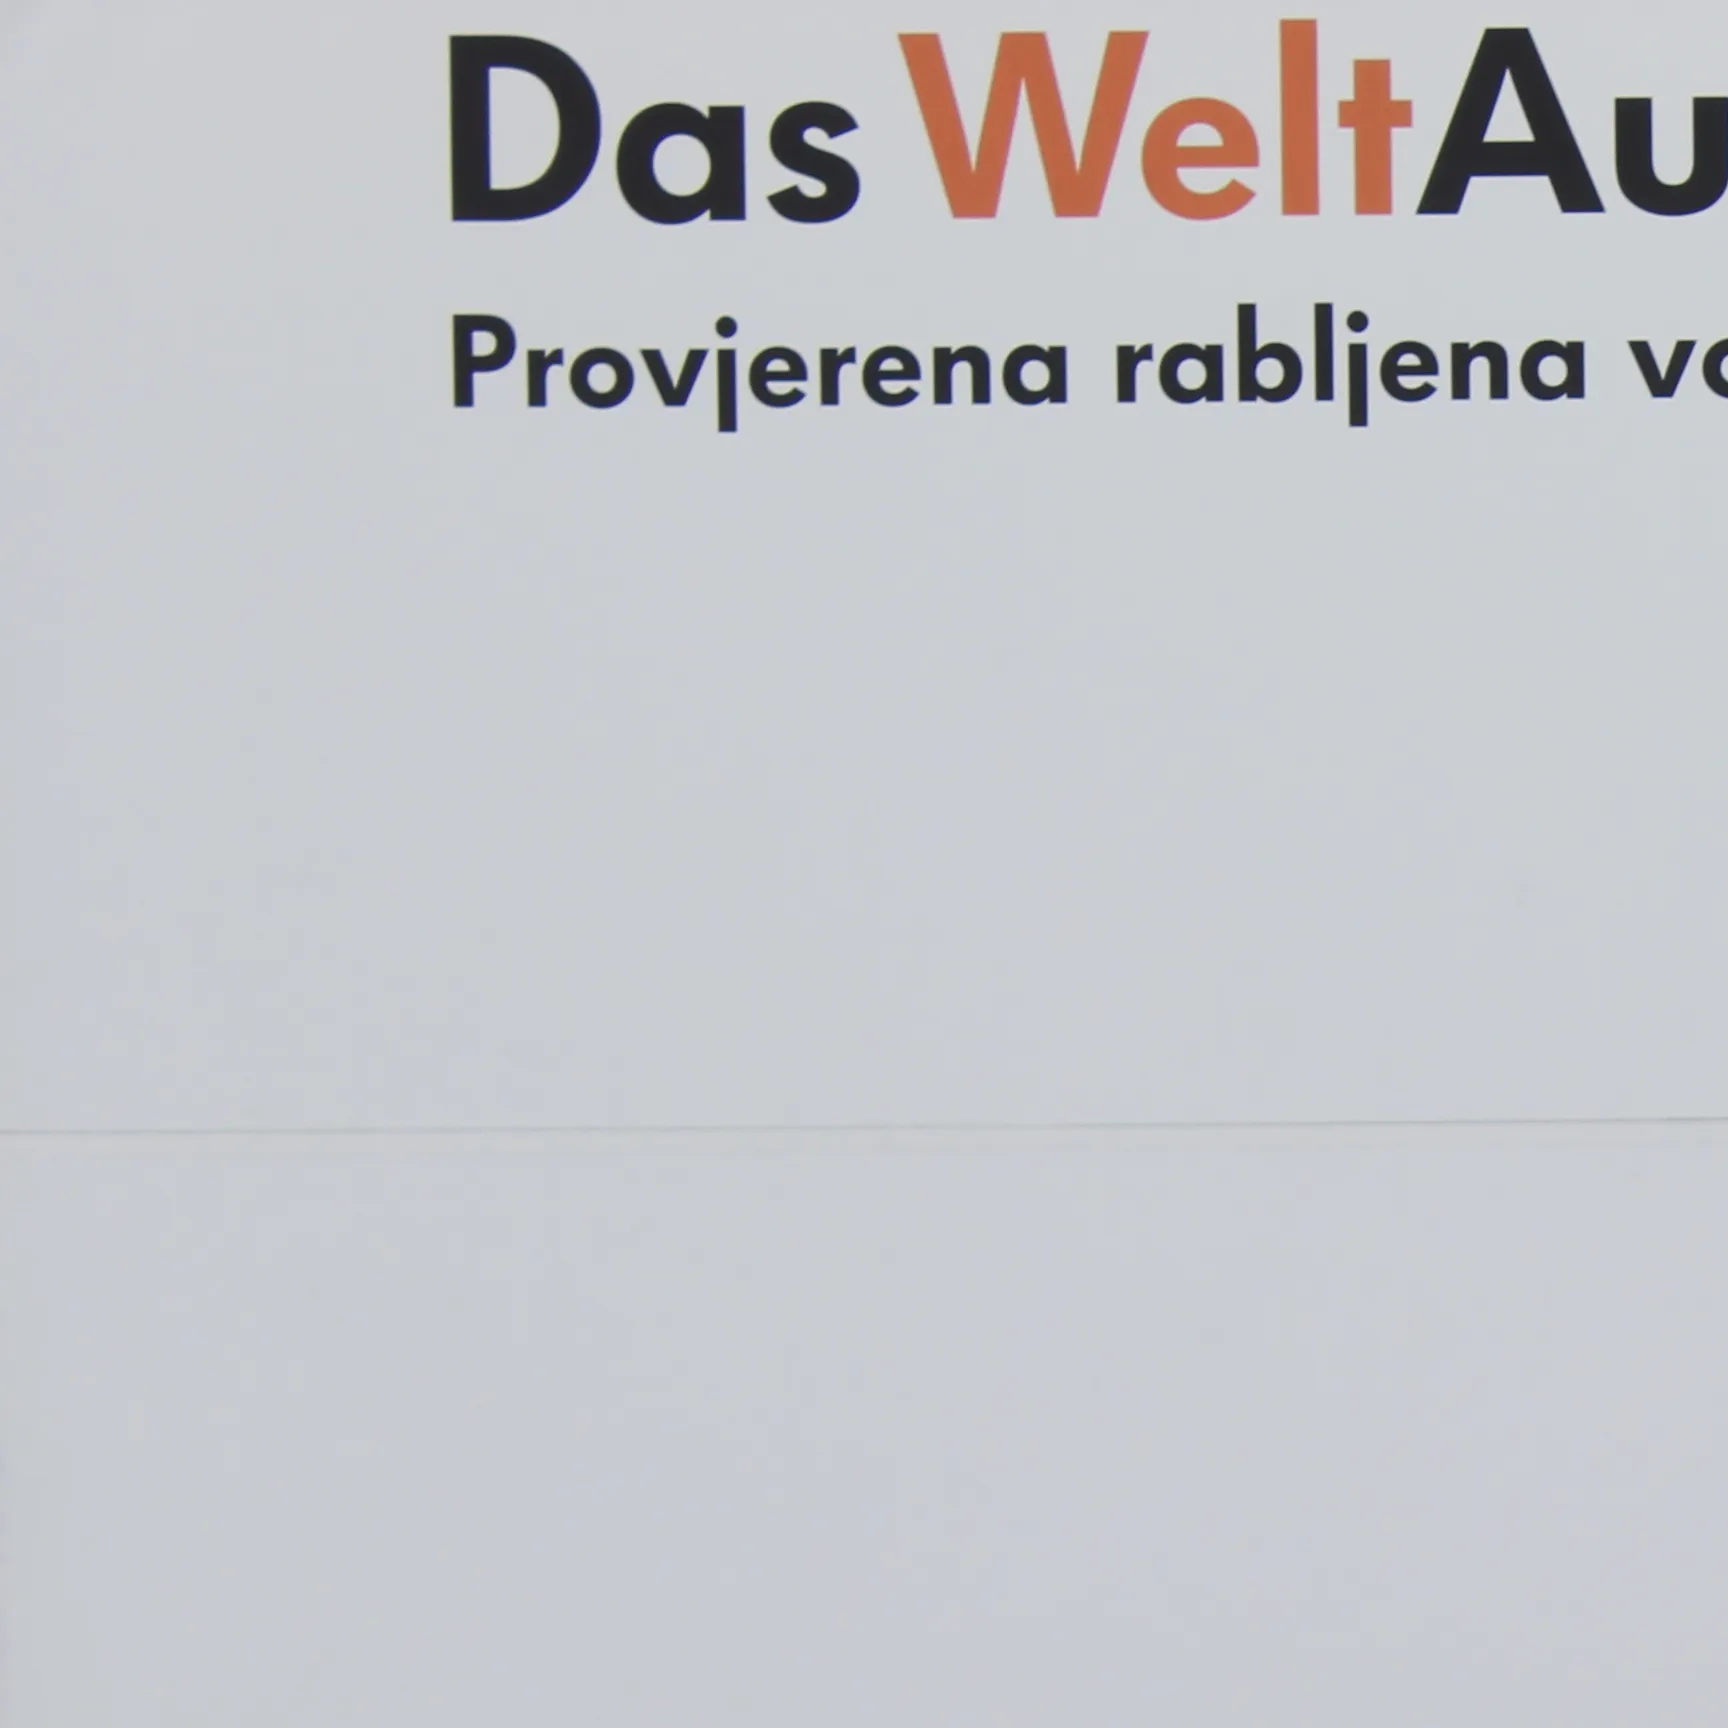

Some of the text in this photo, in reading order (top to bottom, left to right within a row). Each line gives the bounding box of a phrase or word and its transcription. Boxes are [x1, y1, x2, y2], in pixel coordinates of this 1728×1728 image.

[450, 35, 860, 224] Das
[453, 314, 1067, 432] Provjerena
[1117, 303, 1584, 427] rabljena
